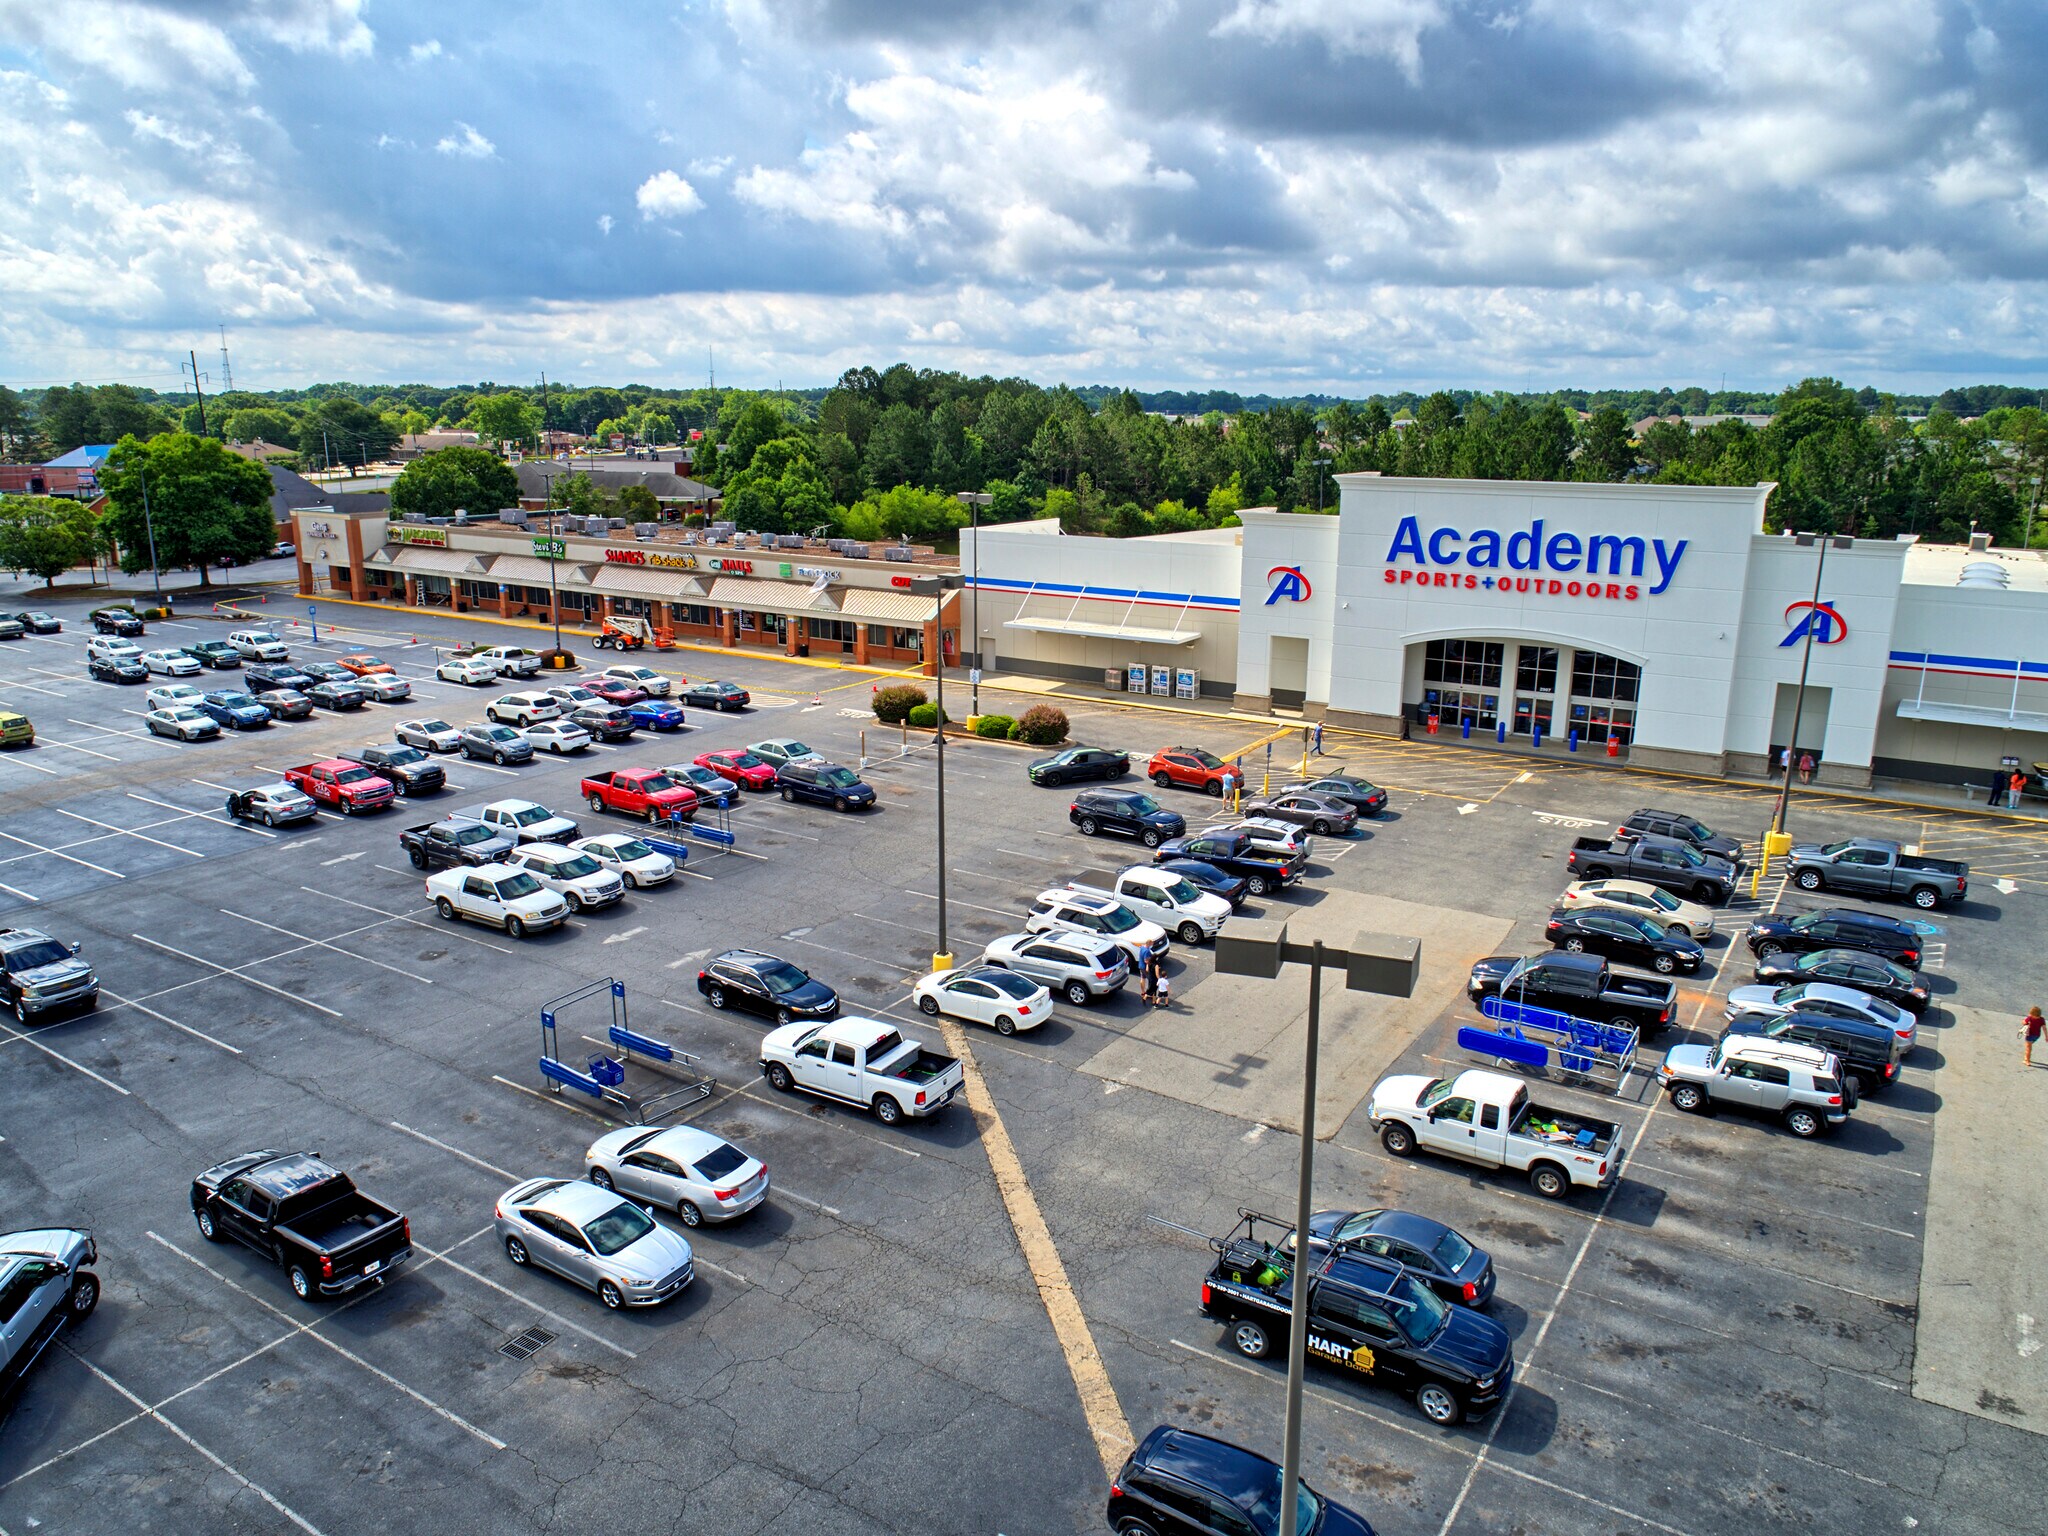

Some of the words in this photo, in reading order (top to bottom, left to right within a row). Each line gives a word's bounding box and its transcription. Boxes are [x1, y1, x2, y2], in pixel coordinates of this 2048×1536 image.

[604, 549, 645, 565] SHANE'S
[1386, 515, 1688, 595] Academy
[722, 559, 752, 574] NAILS
[1537, 816, 1593, 828] STOP
[1308, 1334, 1352, 1360] HART
[1307, 1346, 1342, 1364] Garage
[1345, 1360, 1375, 1376] Doors
